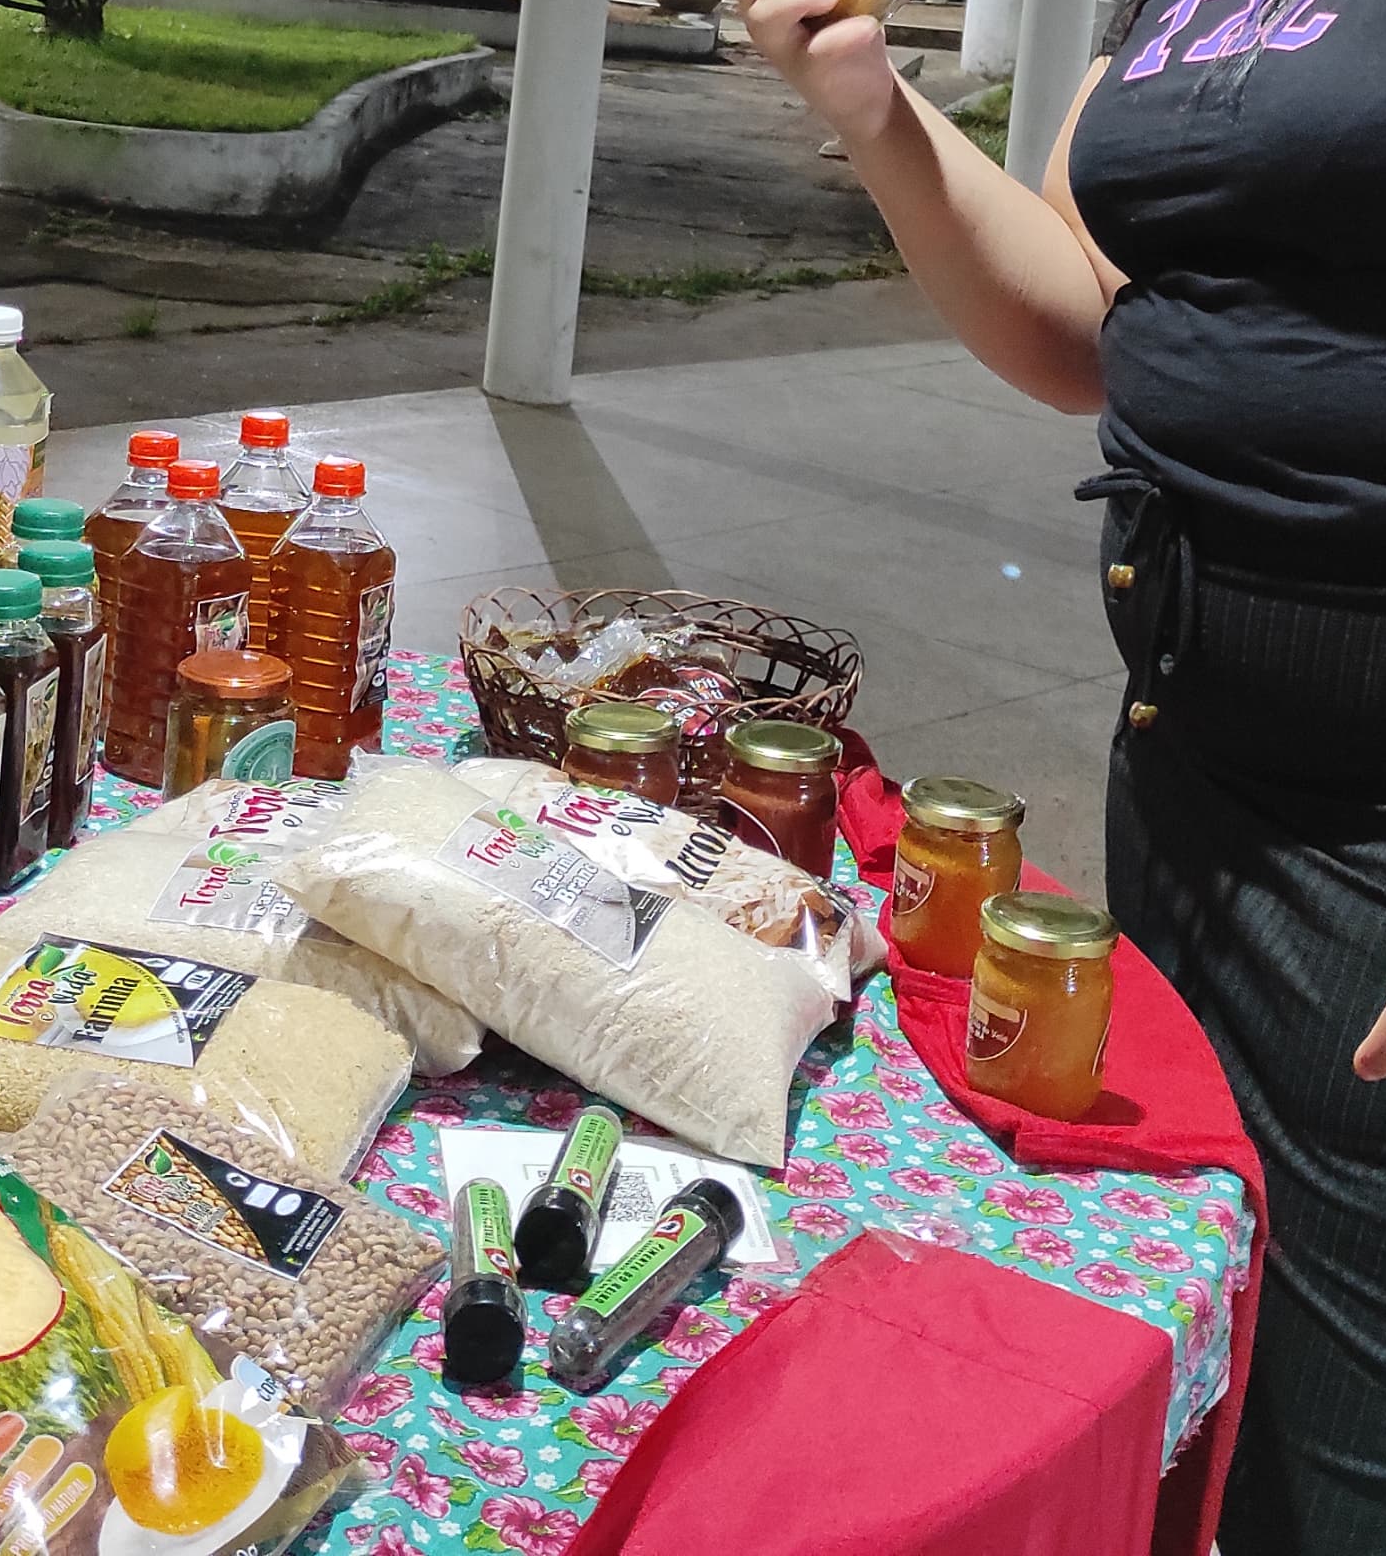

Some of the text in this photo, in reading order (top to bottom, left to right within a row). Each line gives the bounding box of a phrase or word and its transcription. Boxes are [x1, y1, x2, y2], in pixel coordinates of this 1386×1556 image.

[209, 787, 289, 838] Terra
[465, 828, 522, 868] Terra
[665, 821, 734, 890] Arroz
[179, 864, 234, 908] Terra
[72, 976, 141, 1044] Farinha
[594, 1243, 665, 1304] PIMENTA DO REINO
[53, 1478, 88, 1518] NATURAL
